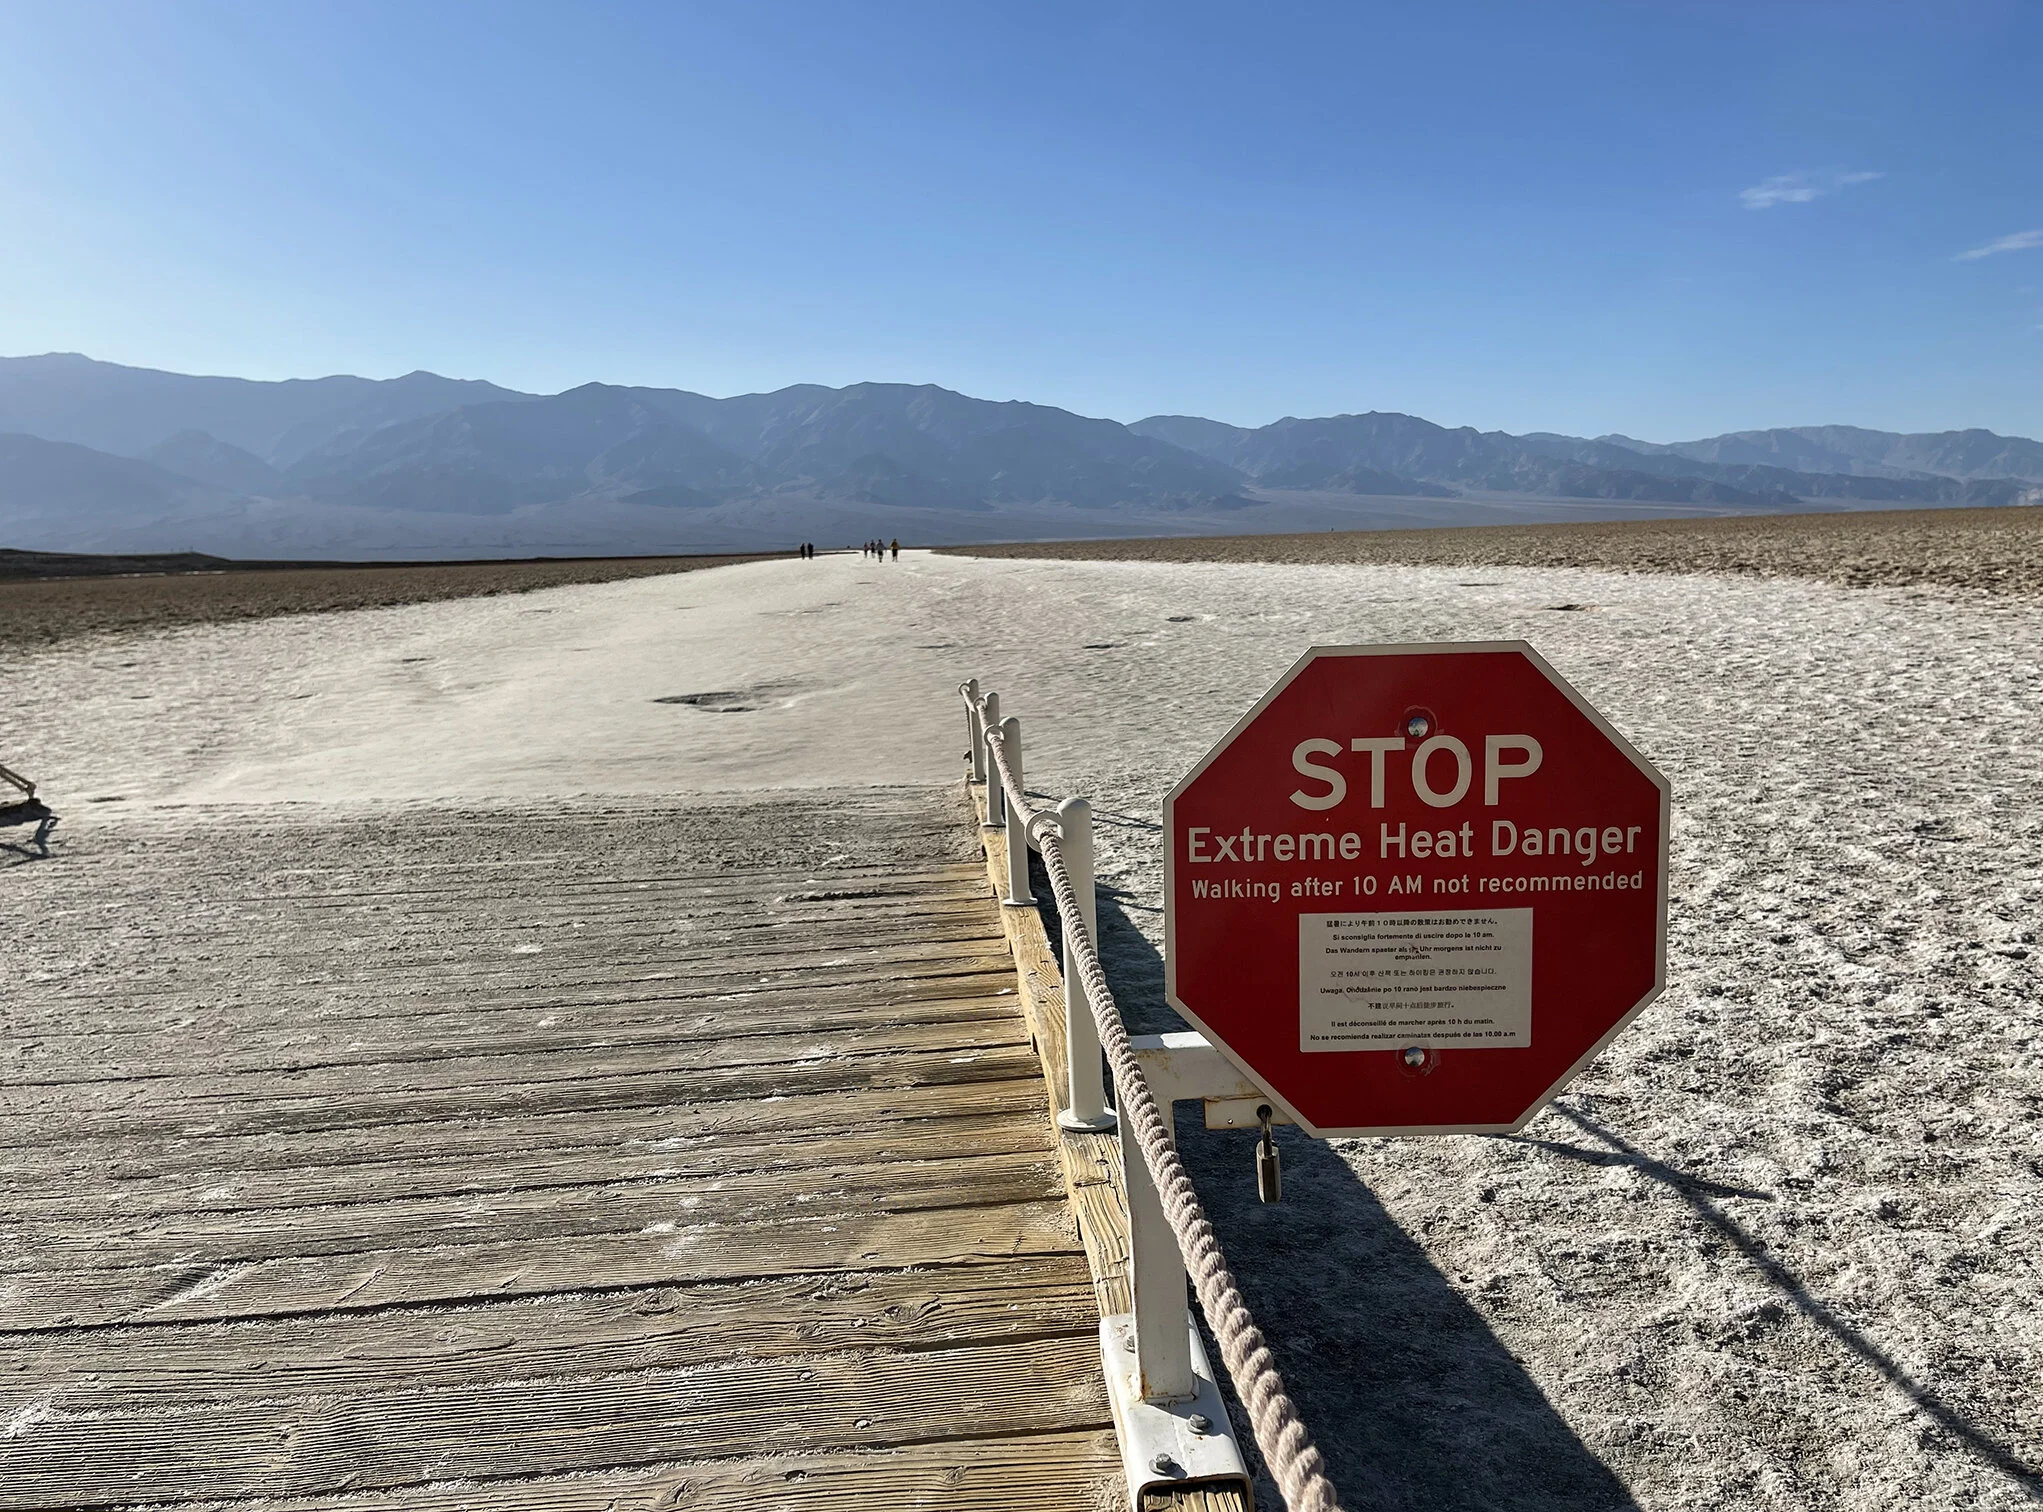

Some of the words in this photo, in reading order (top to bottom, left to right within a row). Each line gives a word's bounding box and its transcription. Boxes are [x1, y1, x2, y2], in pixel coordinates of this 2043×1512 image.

[1289, 734, 1543, 811] STOP
[1188, 826, 1361, 863] Extreme
[1380, 821, 1474, 859] Heat
[1491, 820, 1642, 867] Danger
[1191, 879, 1280, 904] Walking
[1290, 877, 1344, 897] after
[1353, 876, 1377, 895] 10
[1387, 875, 1422, 895] AM
[1433, 875, 1470, 894] not
[1479, 870, 1643, 893] recommended
[1445, 932, 1463, 940] dopo
